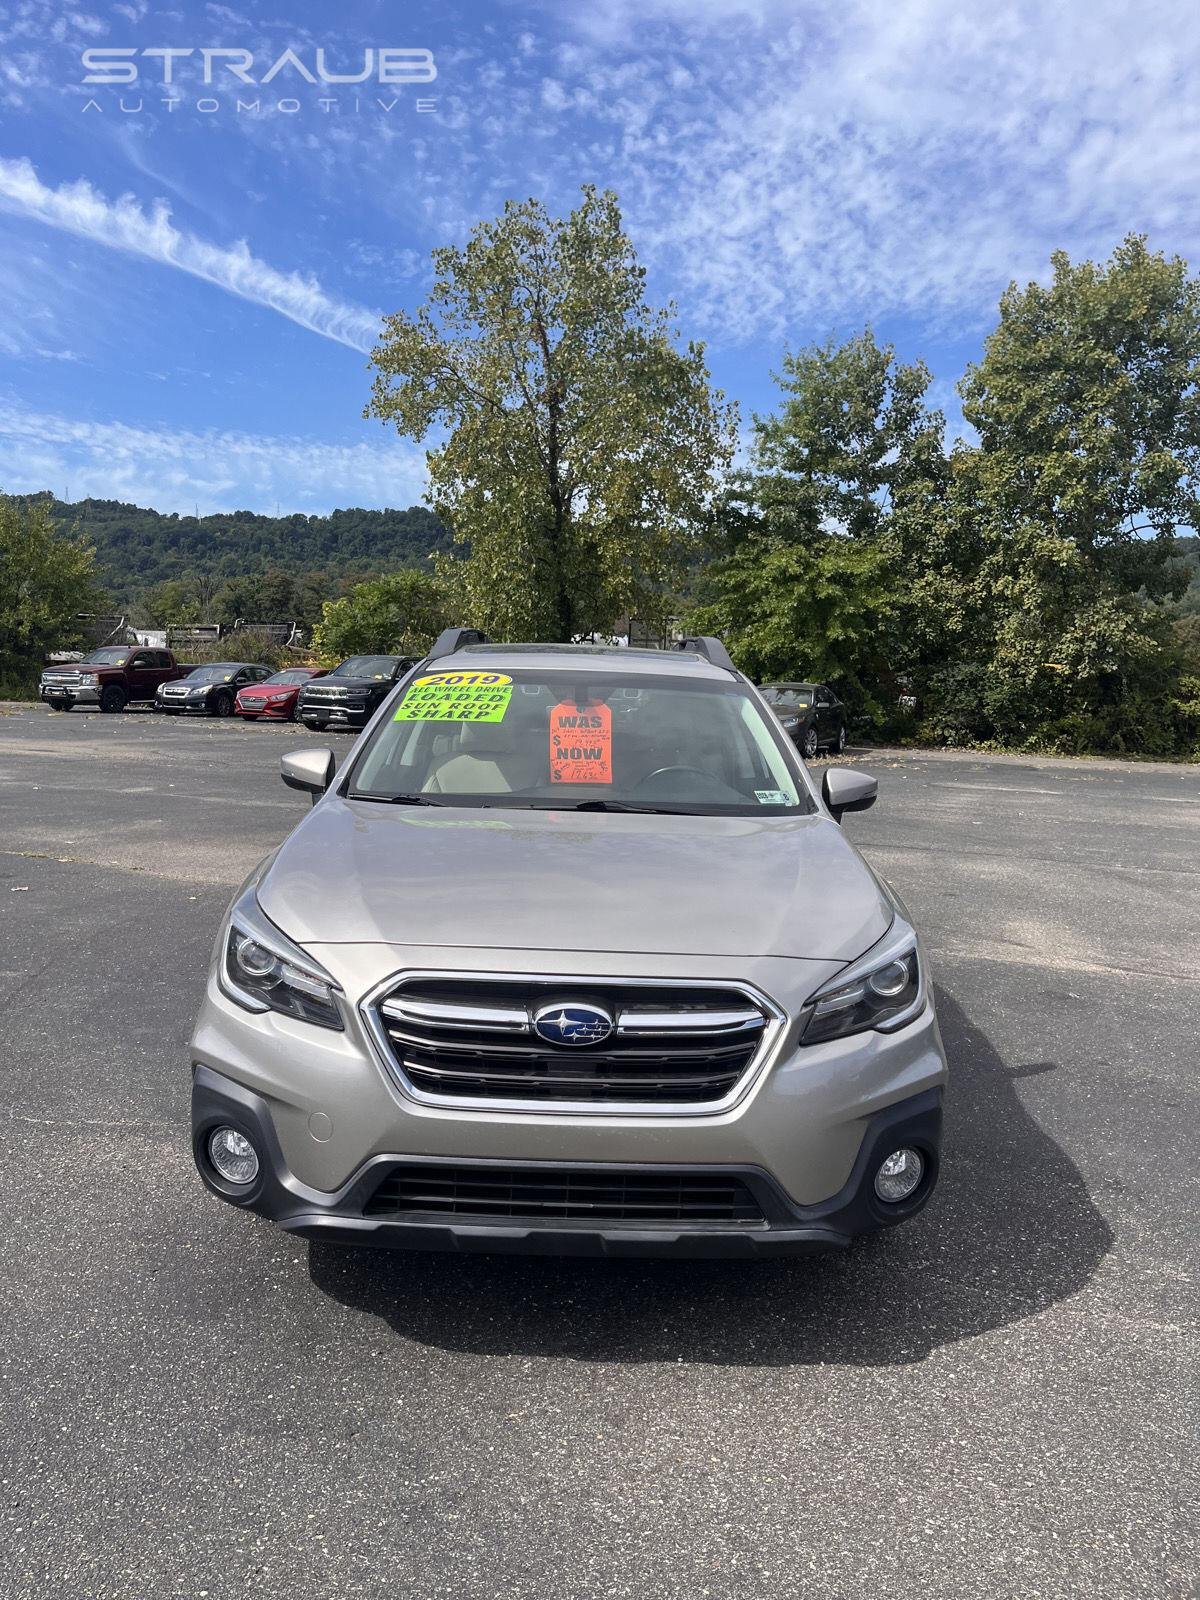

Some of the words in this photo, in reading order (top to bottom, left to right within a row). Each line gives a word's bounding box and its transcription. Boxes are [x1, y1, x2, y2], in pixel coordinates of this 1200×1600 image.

[423, 675, 501, 686] 2019
[475, 686, 512, 694] DRIVE
[407, 693, 506, 703] LOADED
[401, 702, 440, 710] SUN
[448, 702, 506, 711] ROOF
[406, 709, 491, 720] SHARP
[558, 715, 602, 729] WAS
[556, 747, 603, 760] NOW
